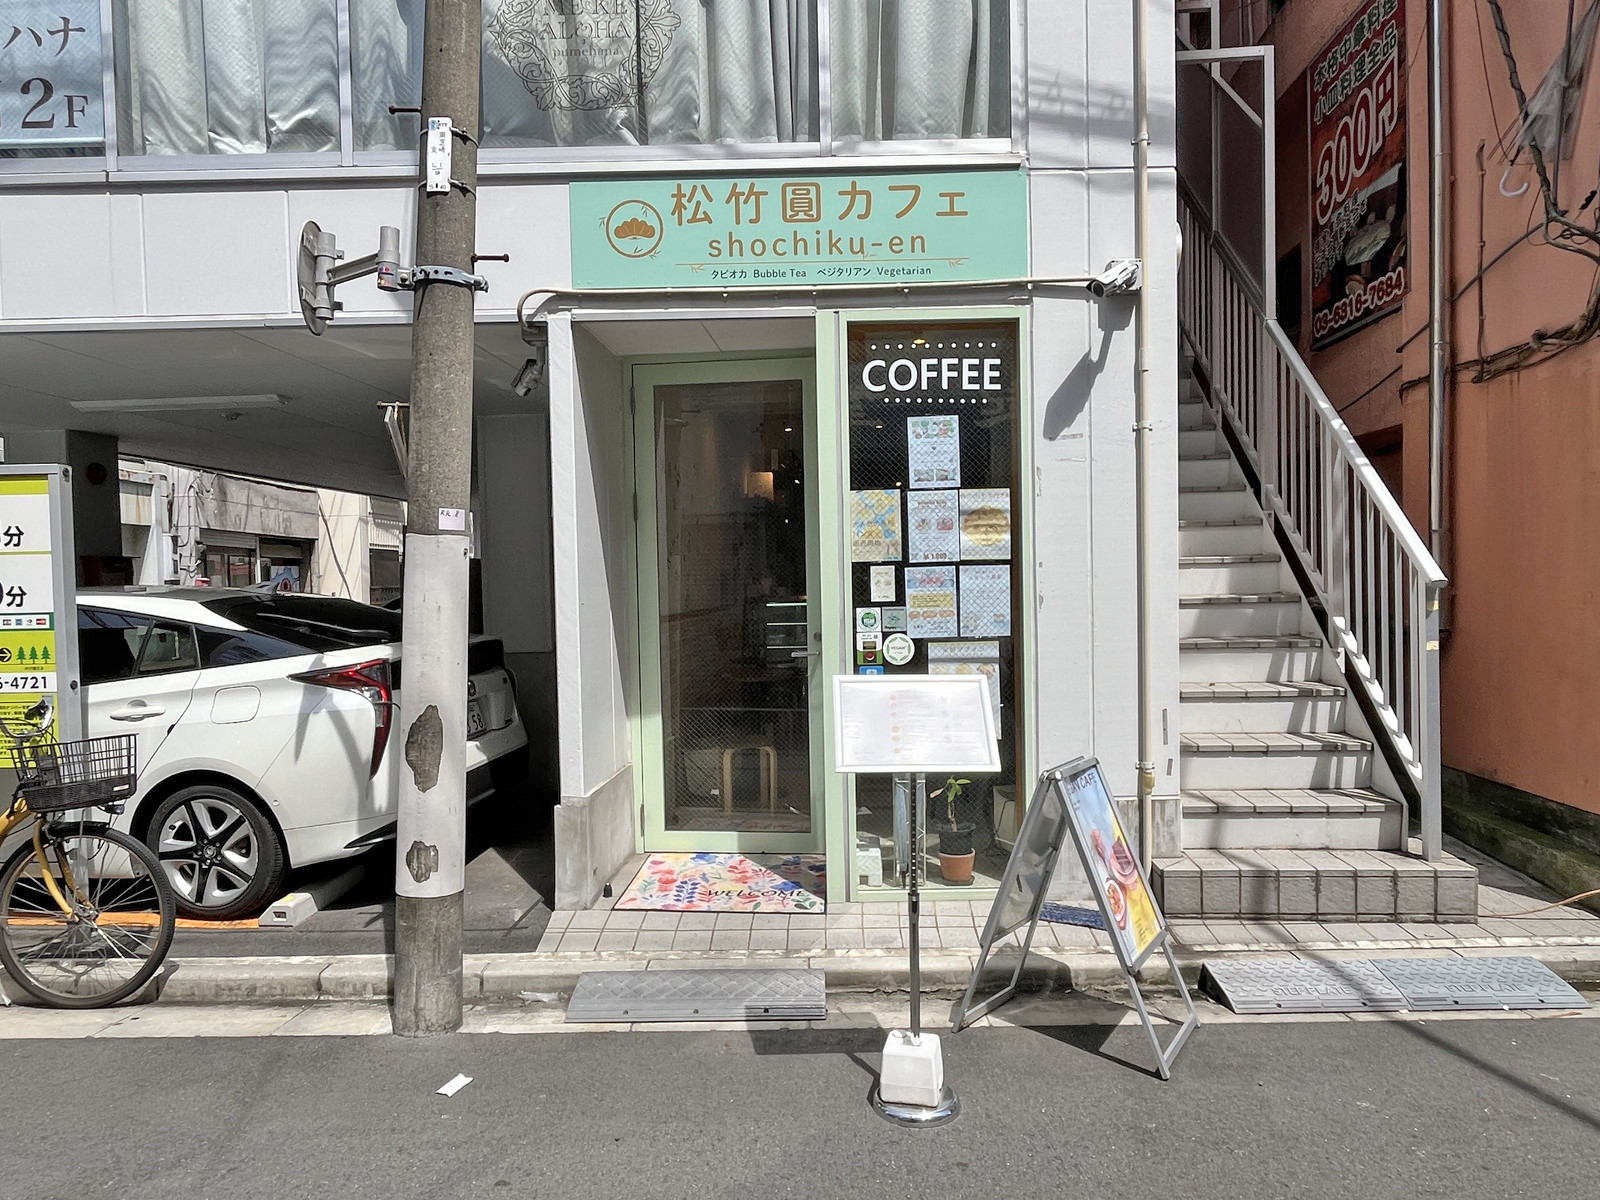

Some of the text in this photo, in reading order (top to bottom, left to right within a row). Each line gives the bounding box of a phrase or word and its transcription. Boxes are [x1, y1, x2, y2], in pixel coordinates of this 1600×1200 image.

[3, 16, 86, 57] ハナ
[540, 20, 631, 39] ALOHA
[1314, 20, 1397, 124] 小皿料理全品
[1316, 47, 1398, 225] 300円
[671, 180, 968, 227] 松竹圓カフェ
[708, 229, 926, 258] shochiku-en
[711, 266, 932, 280] タピオカ Bubble Tea ベジタリアン Vegetarian
[862, 358, 1002, 392] COFFEE
[707, 889, 805, 898] WELCOME
